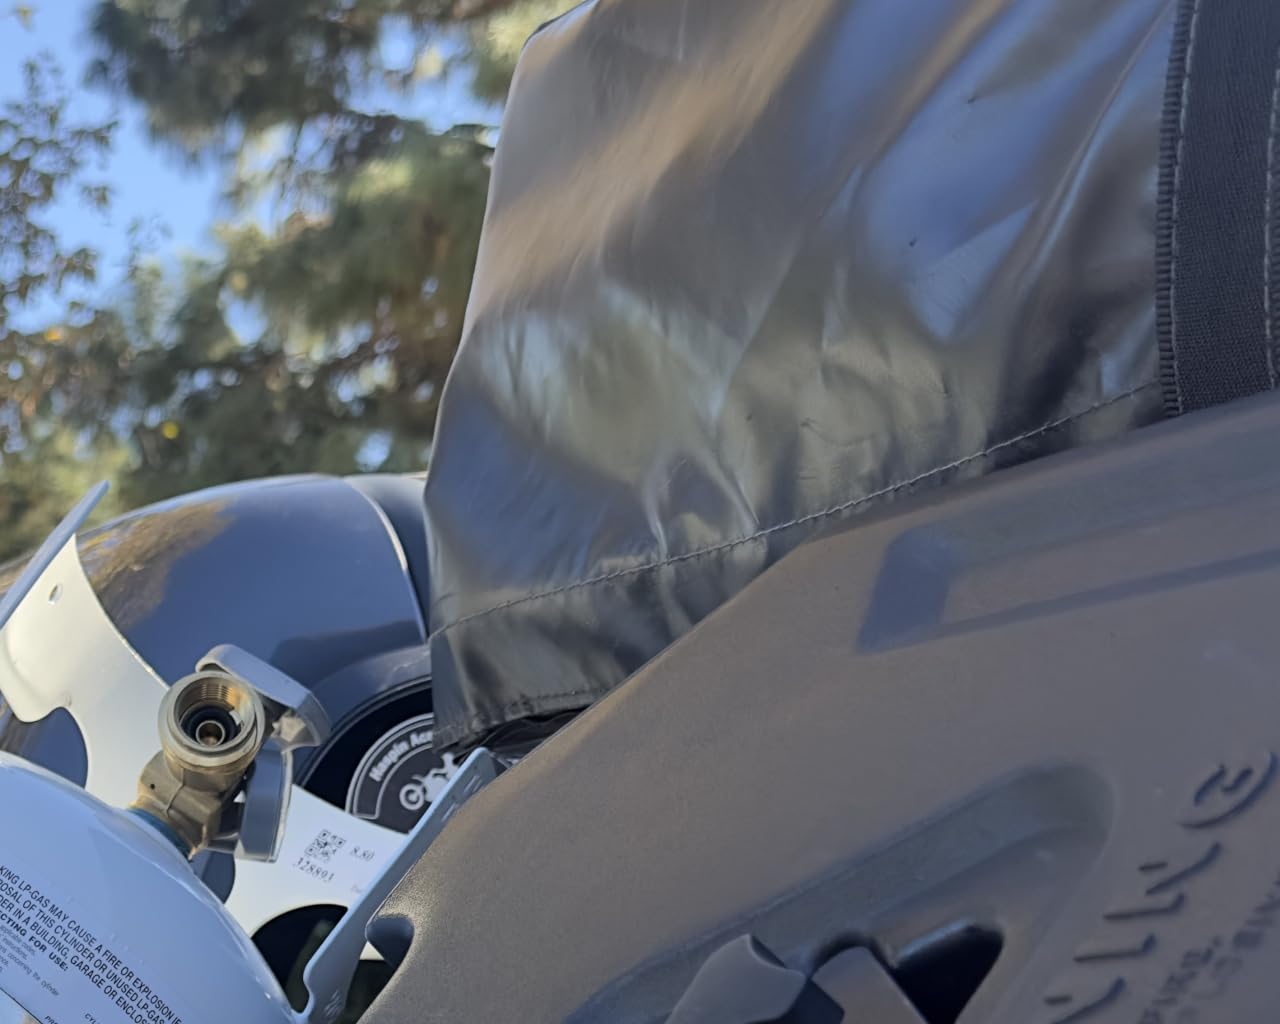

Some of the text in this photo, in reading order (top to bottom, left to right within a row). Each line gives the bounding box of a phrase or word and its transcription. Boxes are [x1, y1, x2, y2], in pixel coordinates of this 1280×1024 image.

[12, 907, 24, 919] IN
[22, 915, 32, 925] A
[29, 921, 72, 959] BUILDING,
[69, 954, 105, 988] GARAGE
[102, 984, 117, 1000] OR
[17, 879, 50, 908] LP-GAS
[48, 903, 69, 923] MAY
[66, 918, 96, 946] CAUSE
[93, 943, 104, 953] A
[101, 949, 122, 969] FIRE
[119, 965, 134, 981] OR
[131, 977, 175, 1020] EXPLOSION
[21, 898, 36, 913] OF
[34, 909, 56, 928] THIS
[52, 924, 95, 962] CYLINDER
[92, 958, 108, 973] OR
[104, 969, 139, 1002] UNUSED
[28, 935, 47, 953] FOR
[47, 951, 69, 971] USE:
